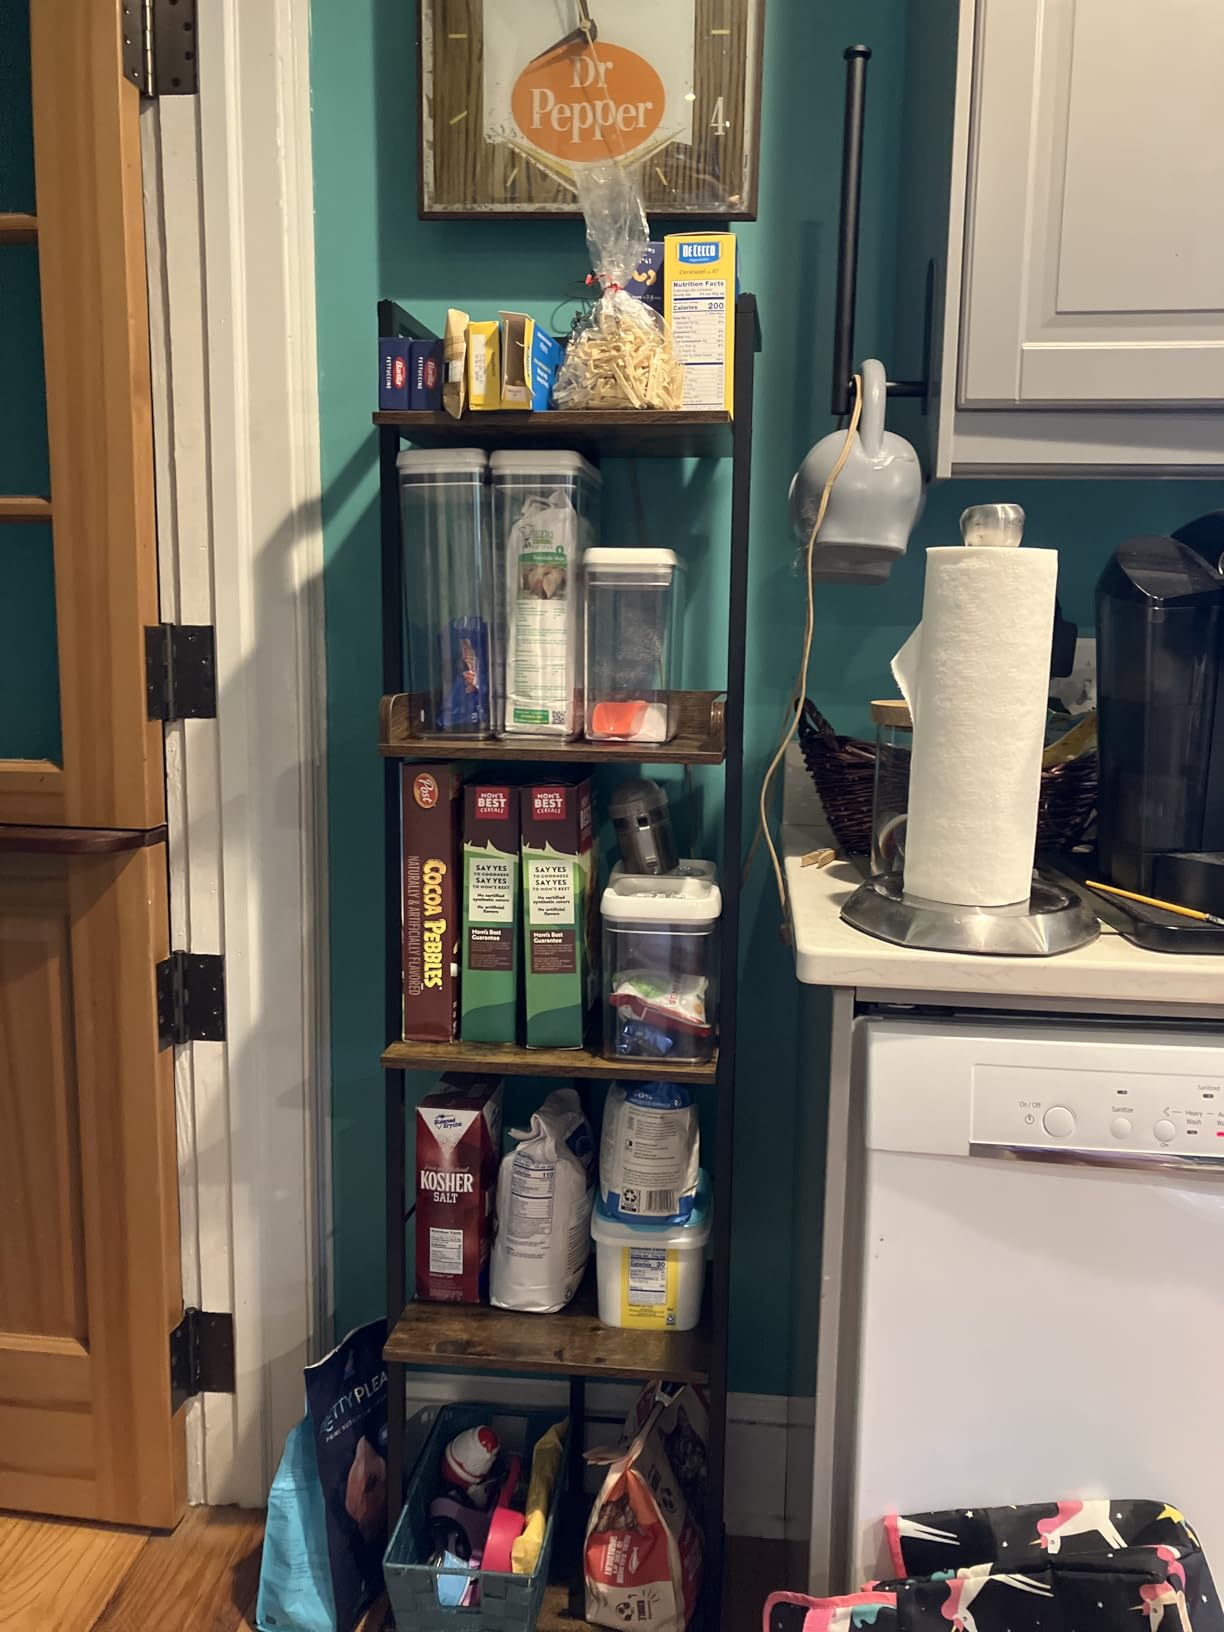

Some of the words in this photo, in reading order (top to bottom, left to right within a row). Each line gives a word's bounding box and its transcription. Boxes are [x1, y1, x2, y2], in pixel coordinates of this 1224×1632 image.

[569, 56, 613, 88] Dr
[529, 88, 653, 143] Pepper
[710, 96, 725, 136] 4
[708, 302, 725, 310] 200
[418, 779, 434, 804] Post
[478, 798, 507, 808] BEST
[534, 799, 563, 809] BEST
[408, 855, 420, 898] NATURALLY
[423, 858, 447, 917] COCOA
[408, 907, 420, 957] ARTIFICIALLY
[423, 918, 447, 988] PEBBLES
[408, 958, 421, 996] FLAVORED
[1185, 1109, 1202, 1117] Heavy
[420, 1170, 474, 1193] KOSHER
[433, 1192, 458, 1203] SALT
